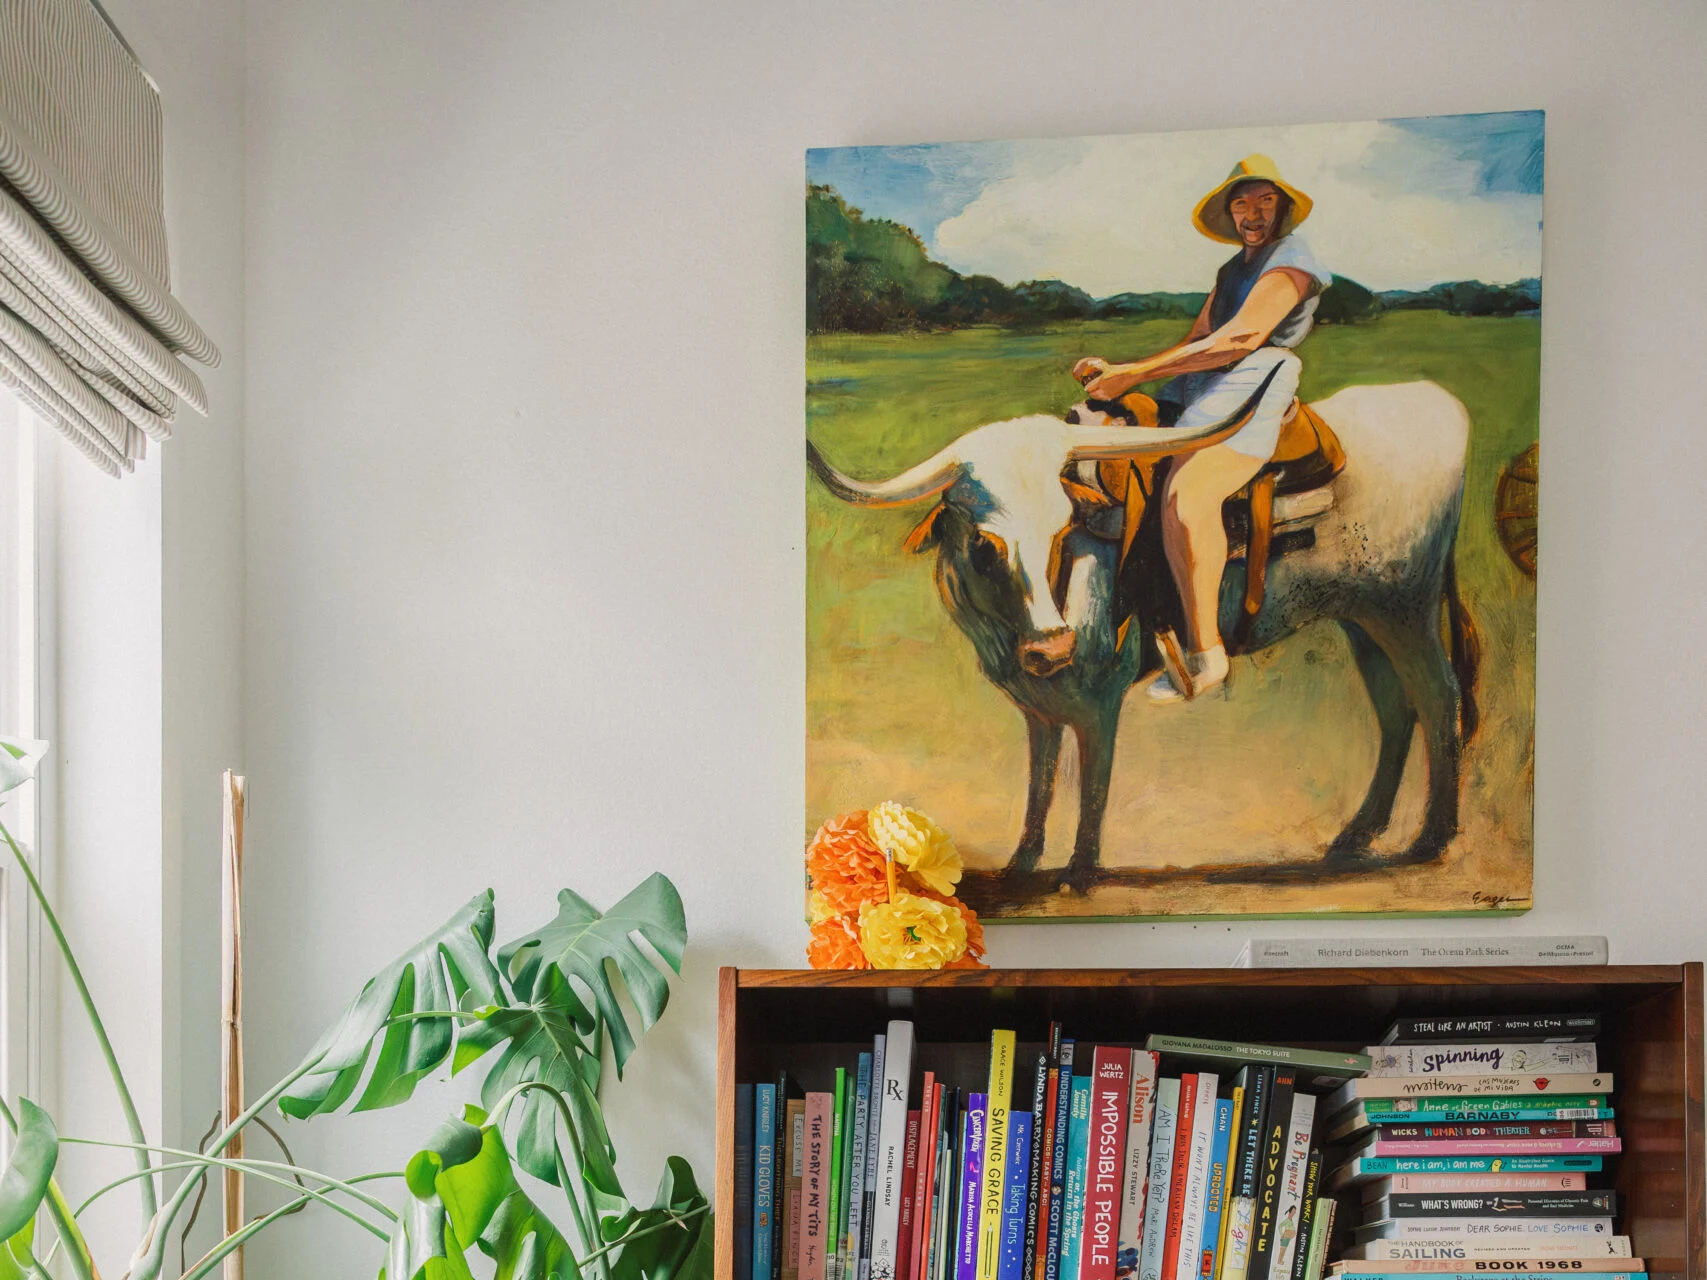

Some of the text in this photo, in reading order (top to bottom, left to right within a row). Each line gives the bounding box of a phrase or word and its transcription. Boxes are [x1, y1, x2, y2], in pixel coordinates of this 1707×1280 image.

[1318, 948, 1408, 957] Richard Diebenkorn
[1420, 947, 1509, 956] The Ocean Park Series
[1414, 1023, 1435, 1032] STEAL
[1438, 1022, 1452, 1032] LIKE
[1456, 1022, 1466, 1031] AN
[1468, 1022, 1492, 1032] ARTIST
[1534, 1020, 1561, 1028] KLEON
[1102, 1062, 1122, 1071] JULIA
[1192, 1043, 1290, 1058] MADALOSSO THE TOKYO SUITE
[1422, 1048, 1504, 1073] Spinning
[1099, 1071, 1124, 1080] WERTZ
[869, 1050, 882, 1153] CHARLOTTE JANE
[1056, 1071, 1070, 1143] UNDERSTANDING
[1071, 1090, 1080, 1119] Jourdy
[1079, 1089, 1088, 1120] Camille
[1133, 1072, 1151, 1124] Alison
[1423, 1100, 1522, 1112] Anne Green Gables
[1392, 1126, 1532, 1136] WICKS HUMAN THEATER
[1445, 1111, 1520, 1120] BARNABY
[849, 1066, 868, 1228] THE AFTER YOU LEFT
[906, 1121, 918, 1169] DISPLACEMENT
[990, 1108, 1004, 1162] SAVING
[759, 1145, 771, 1164] KID
[809, 1114, 822, 1208] THE STORY OF MY
[1054, 1145, 1064, 1179] COMICS
[1208, 1107, 1227, 1212] CHAN UPROOTED
[1243, 1129, 1257, 1194] LET THERE BE
[1286, 1131, 1309, 1200] Be Pregnant
[1309, 1161, 1318, 1180] SHOW
[1367, 1160, 1486, 1170] BEAN here am me
[758, 1167, 771, 1207] GLOVES
[884, 1146, 894, 1207] RACHEL LINDSAY
[987, 1168, 1001, 1215] GRACE
[1092, 1091, 1118, 1266] IMPOSSIBLE PEOPLE
[1129, 1149, 1140, 1206] LIZZY STEWART
[1258, 1125, 1282, 1252] ADVOCATE
[1027, 1150, 1040, 1245] MAKING COMICS
[1061, 1170, 1075, 1257] Return Spring
[1303, 1200, 1311, 1223] WORK!
[1421, 1200, 1484, 1210] WHAT'S WRONG?
[1005, 1184, 1026, 1245] Taking Turns
[1049, 1200, 1060, 1234] SCOTT
[1183, 1175, 1202, 1268] ALWAYS LIKE THIS
[1467, 1224, 1490, 1234] DEAR
[1528, 1224, 1548, 1233] LOVE
[1553, 1223, 1588, 1234] SOPHIE
[1389, 1248, 1466, 1258] SAILING
[1400, 1240, 1455, 1248] HANDBOOK
[1296, 1255, 1304, 1277] KLEON
[1405, 1260, 1582, 1271] June BOOK 1968
